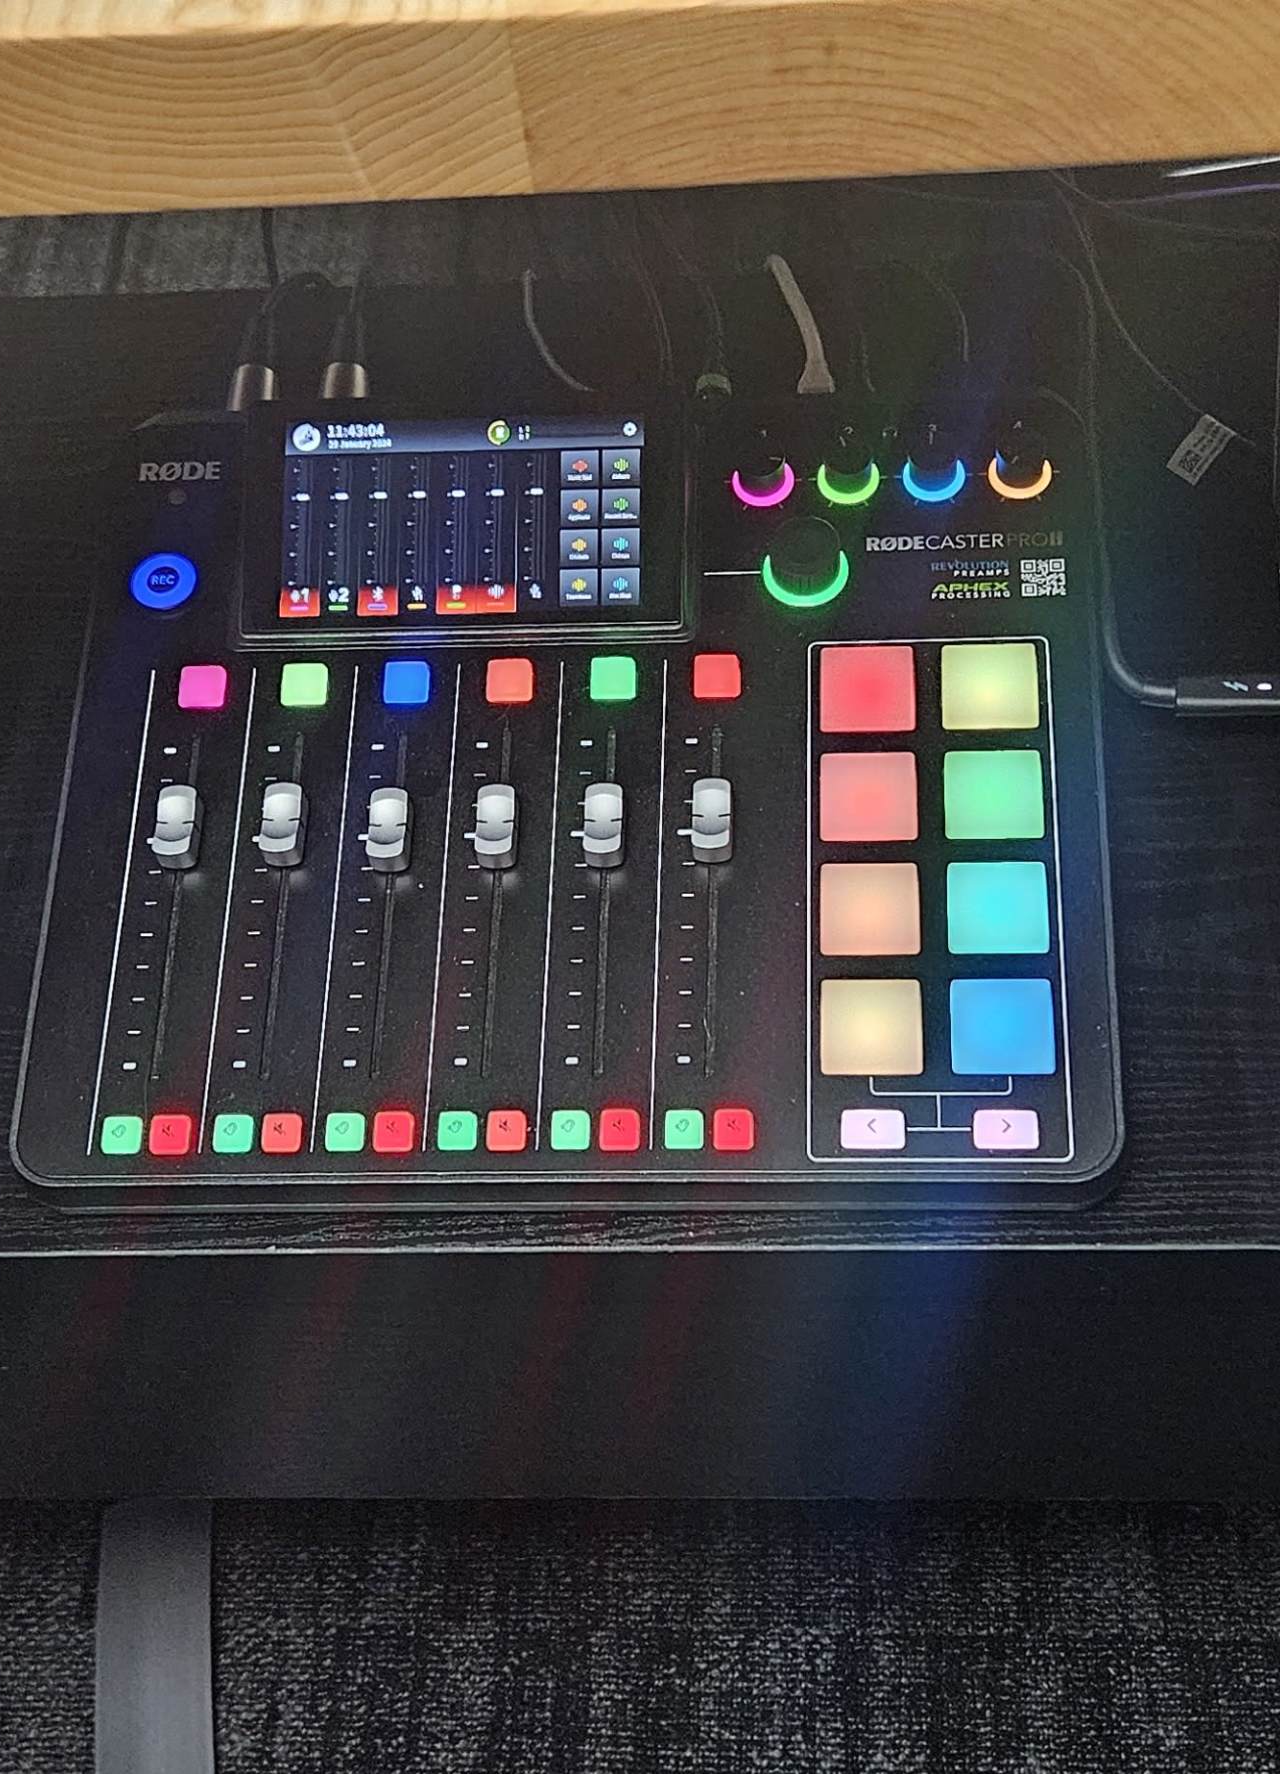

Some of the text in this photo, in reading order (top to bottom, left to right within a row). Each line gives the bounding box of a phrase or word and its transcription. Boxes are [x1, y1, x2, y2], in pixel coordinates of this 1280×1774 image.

[953, 569, 1011, 577] PREAMPS
[932, 581, 1010, 592] APHEX
[931, 591, 1011, 599] PROCESSING
